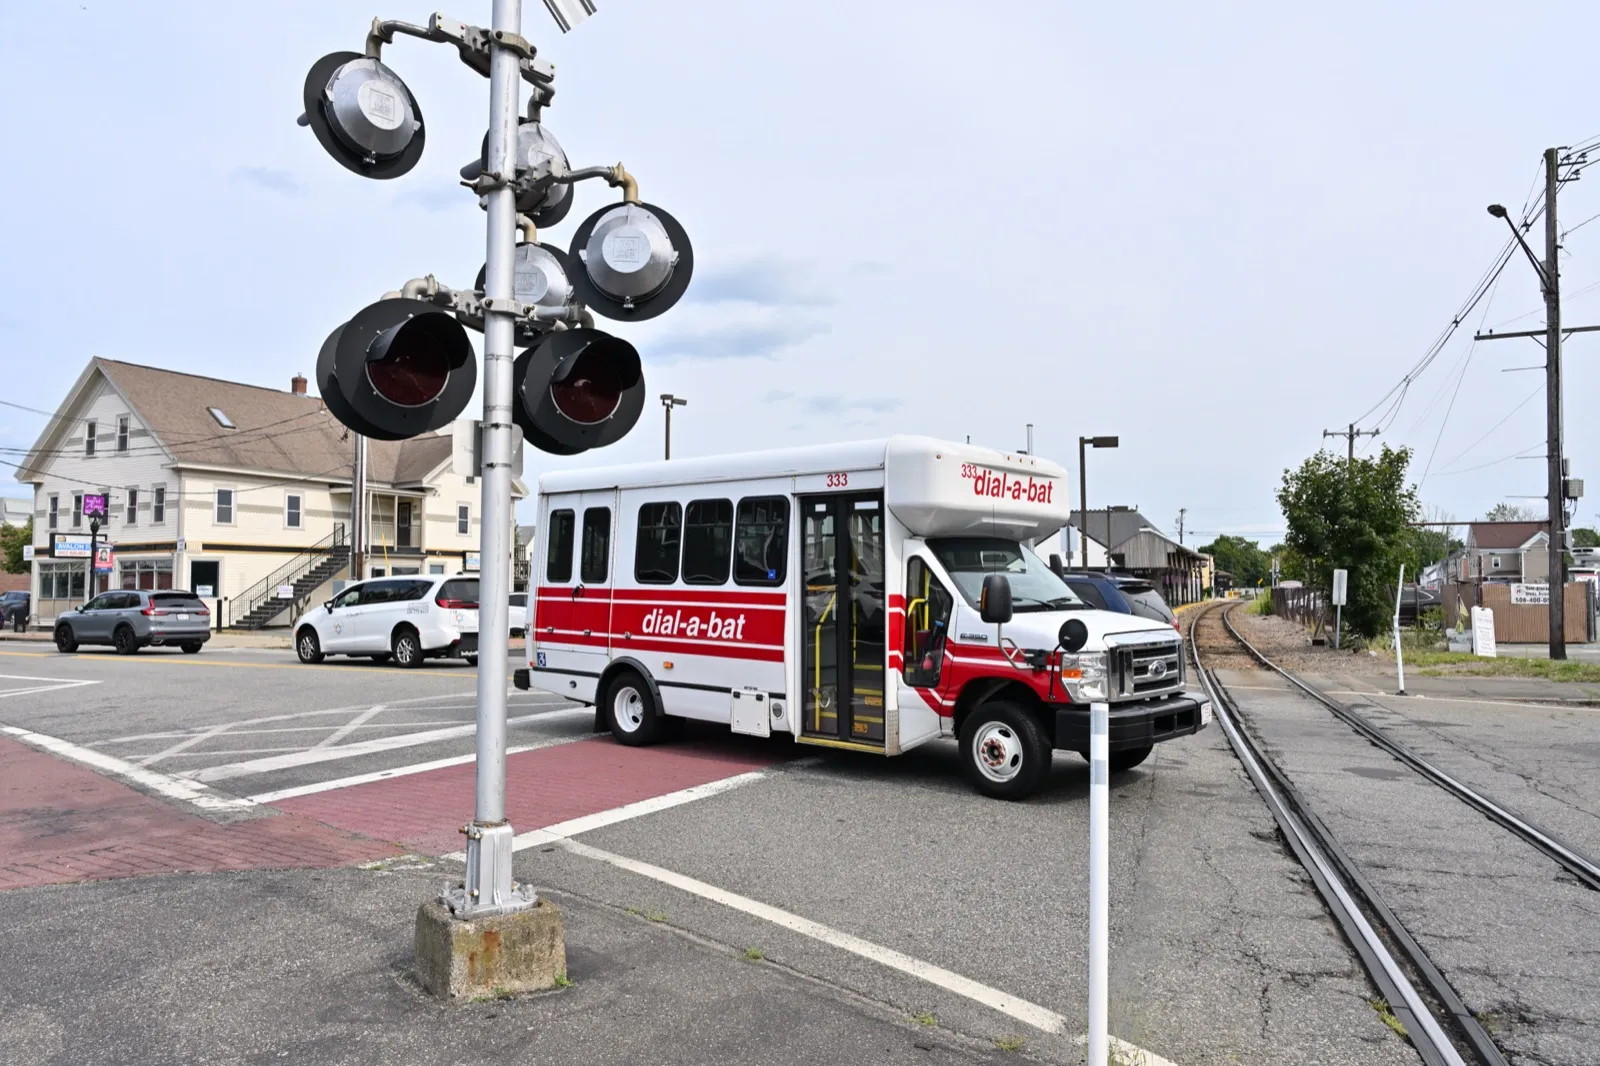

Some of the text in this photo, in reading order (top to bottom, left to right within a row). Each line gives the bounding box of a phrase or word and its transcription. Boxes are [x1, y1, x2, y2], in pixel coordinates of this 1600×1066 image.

[827, 473, 848, 487] 333
[961, 464, 977, 479] 333
[974, 469, 1053, 504] dial-a-bat
[642, 608, 746, 639] dial-a-bat
